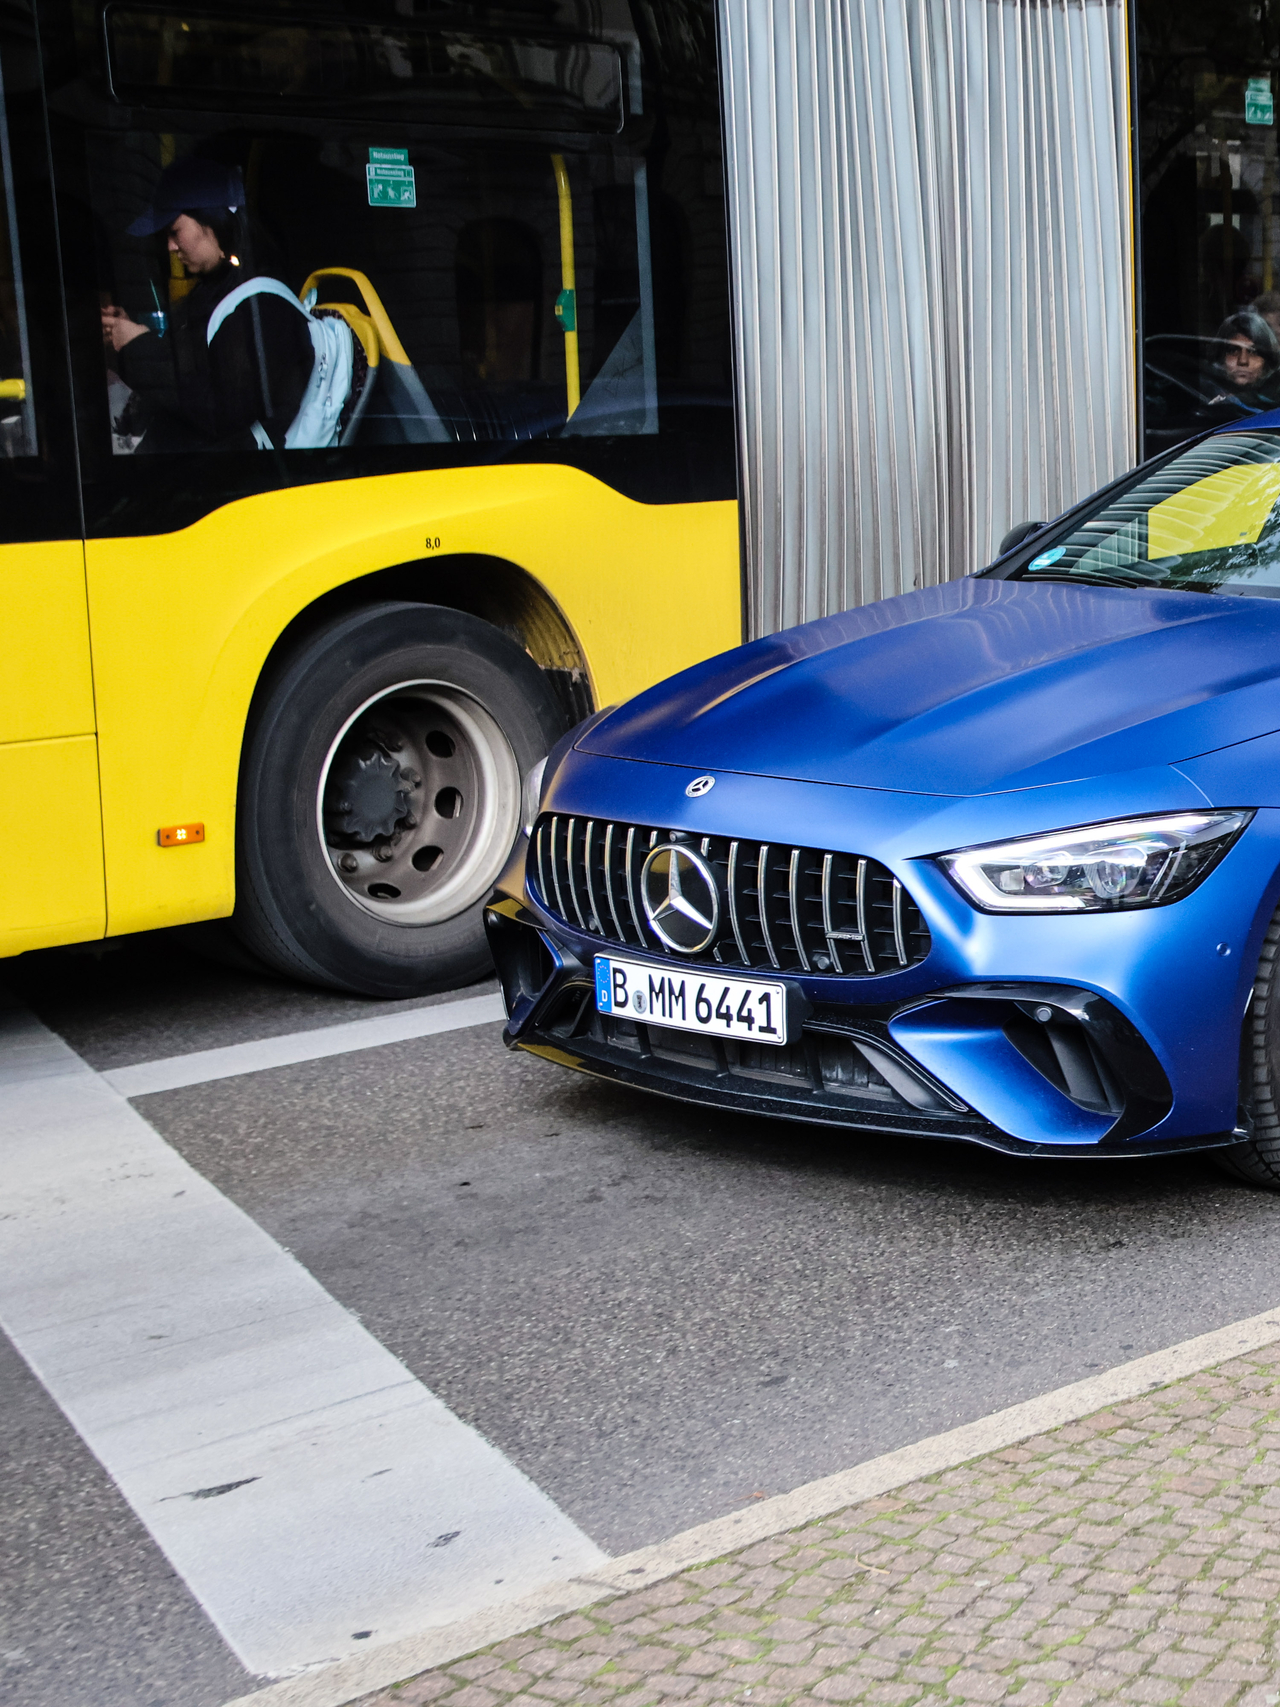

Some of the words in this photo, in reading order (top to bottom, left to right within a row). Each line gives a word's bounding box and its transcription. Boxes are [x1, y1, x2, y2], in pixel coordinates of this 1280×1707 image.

[425, 537, 441, 550] 8,0
[601, 989, 608, 1002] D
[612, 967, 629, 1009] B
[648, 973, 687, 1021] MM
[695, 983, 778, 1035] 6441
